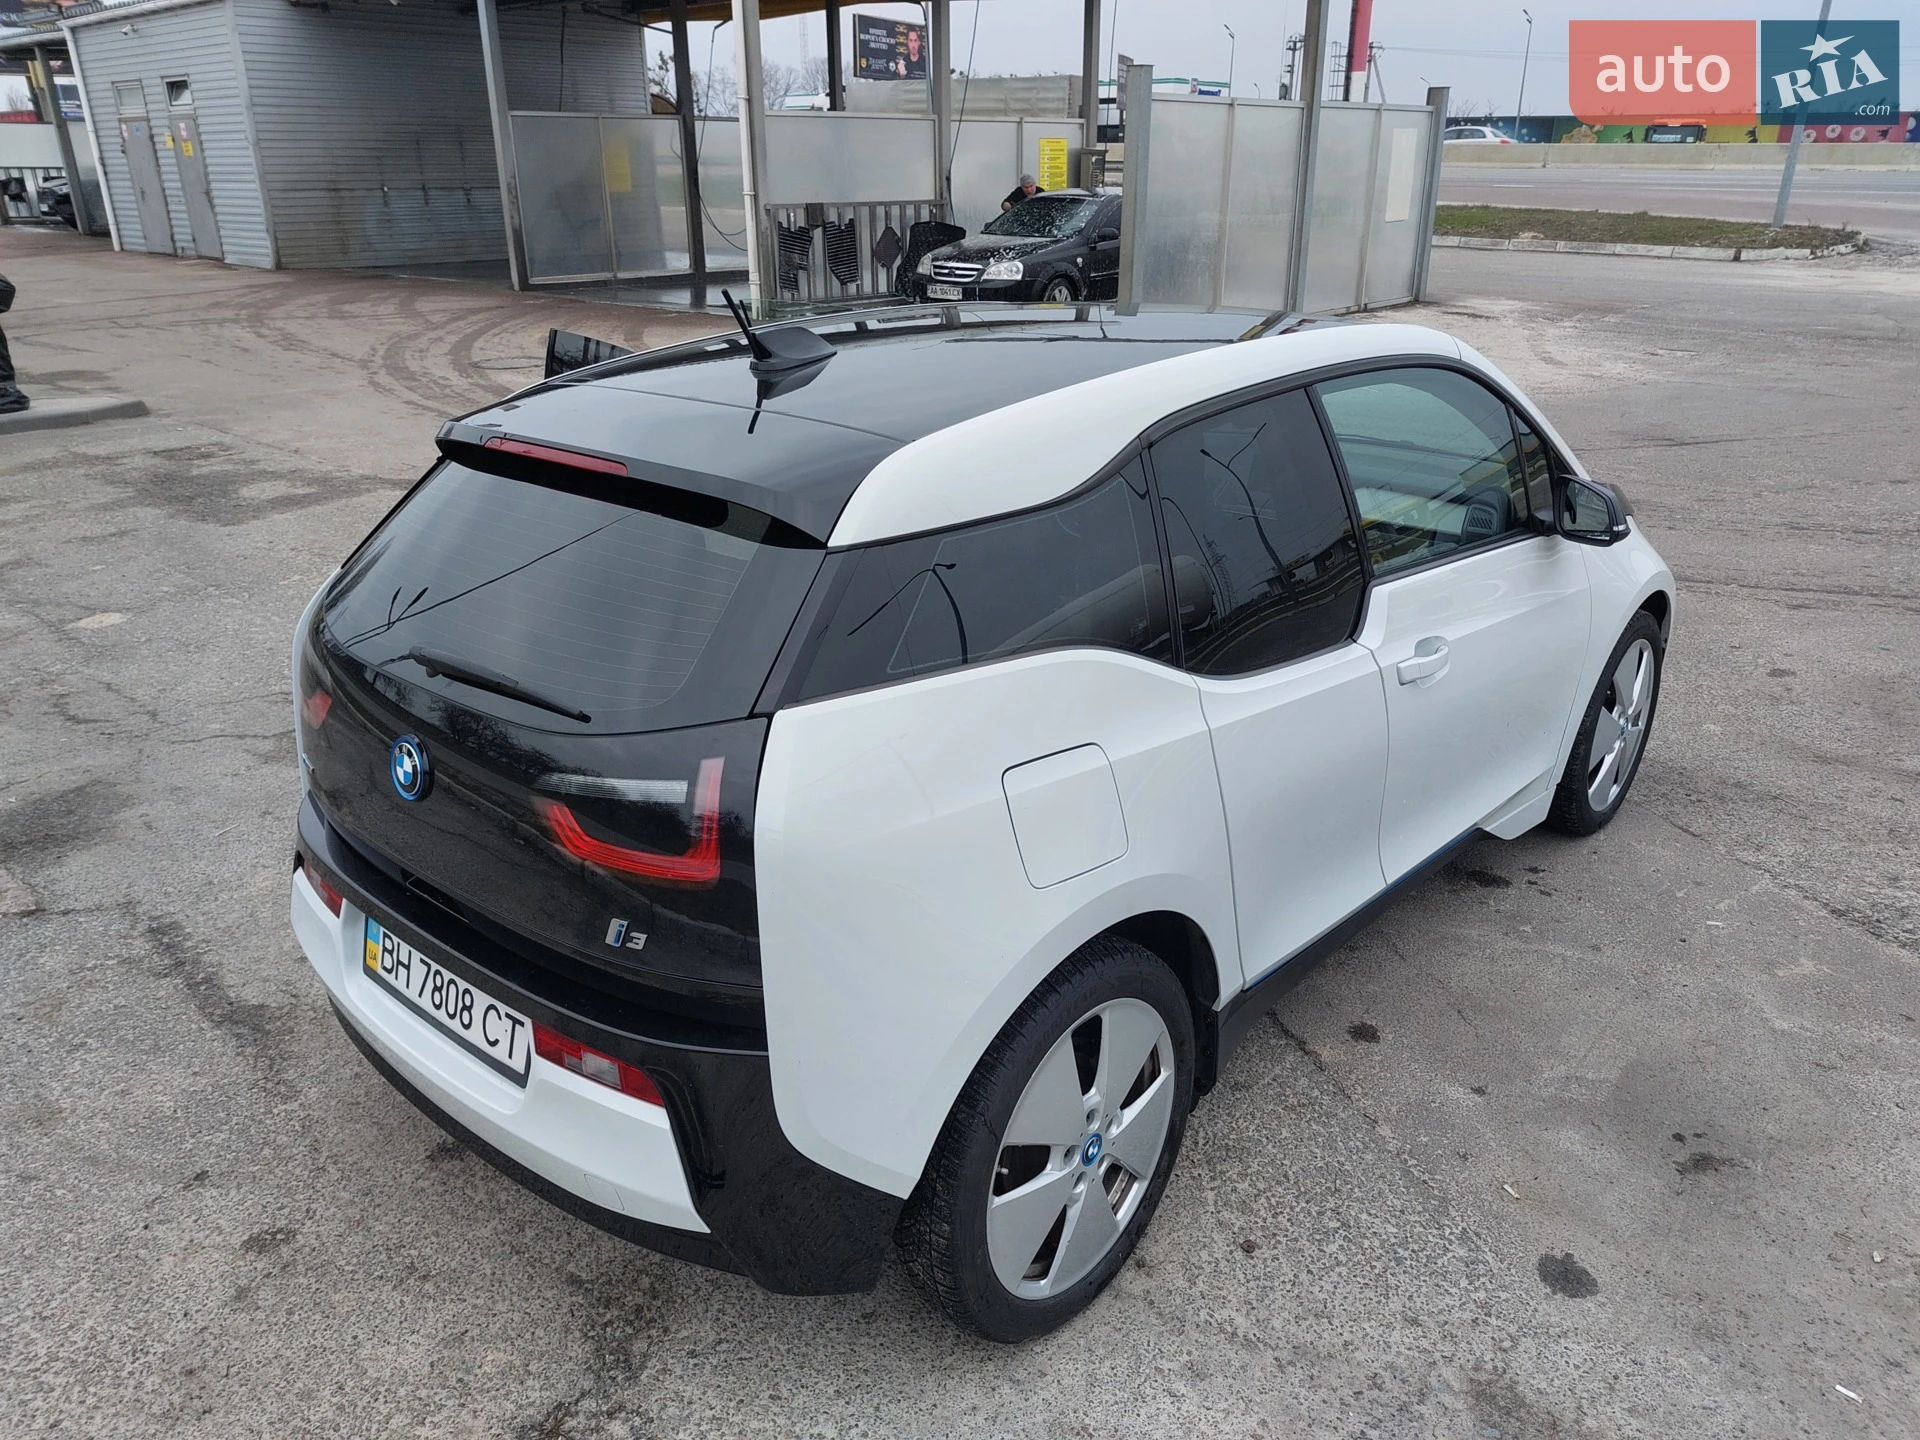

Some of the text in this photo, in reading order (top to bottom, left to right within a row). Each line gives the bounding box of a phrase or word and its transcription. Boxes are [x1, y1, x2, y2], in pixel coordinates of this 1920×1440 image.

[394, 744, 417, 766] BMW
[368, 949, 378, 964] UA
[381, 930, 525, 1060] BH 7808 CT
